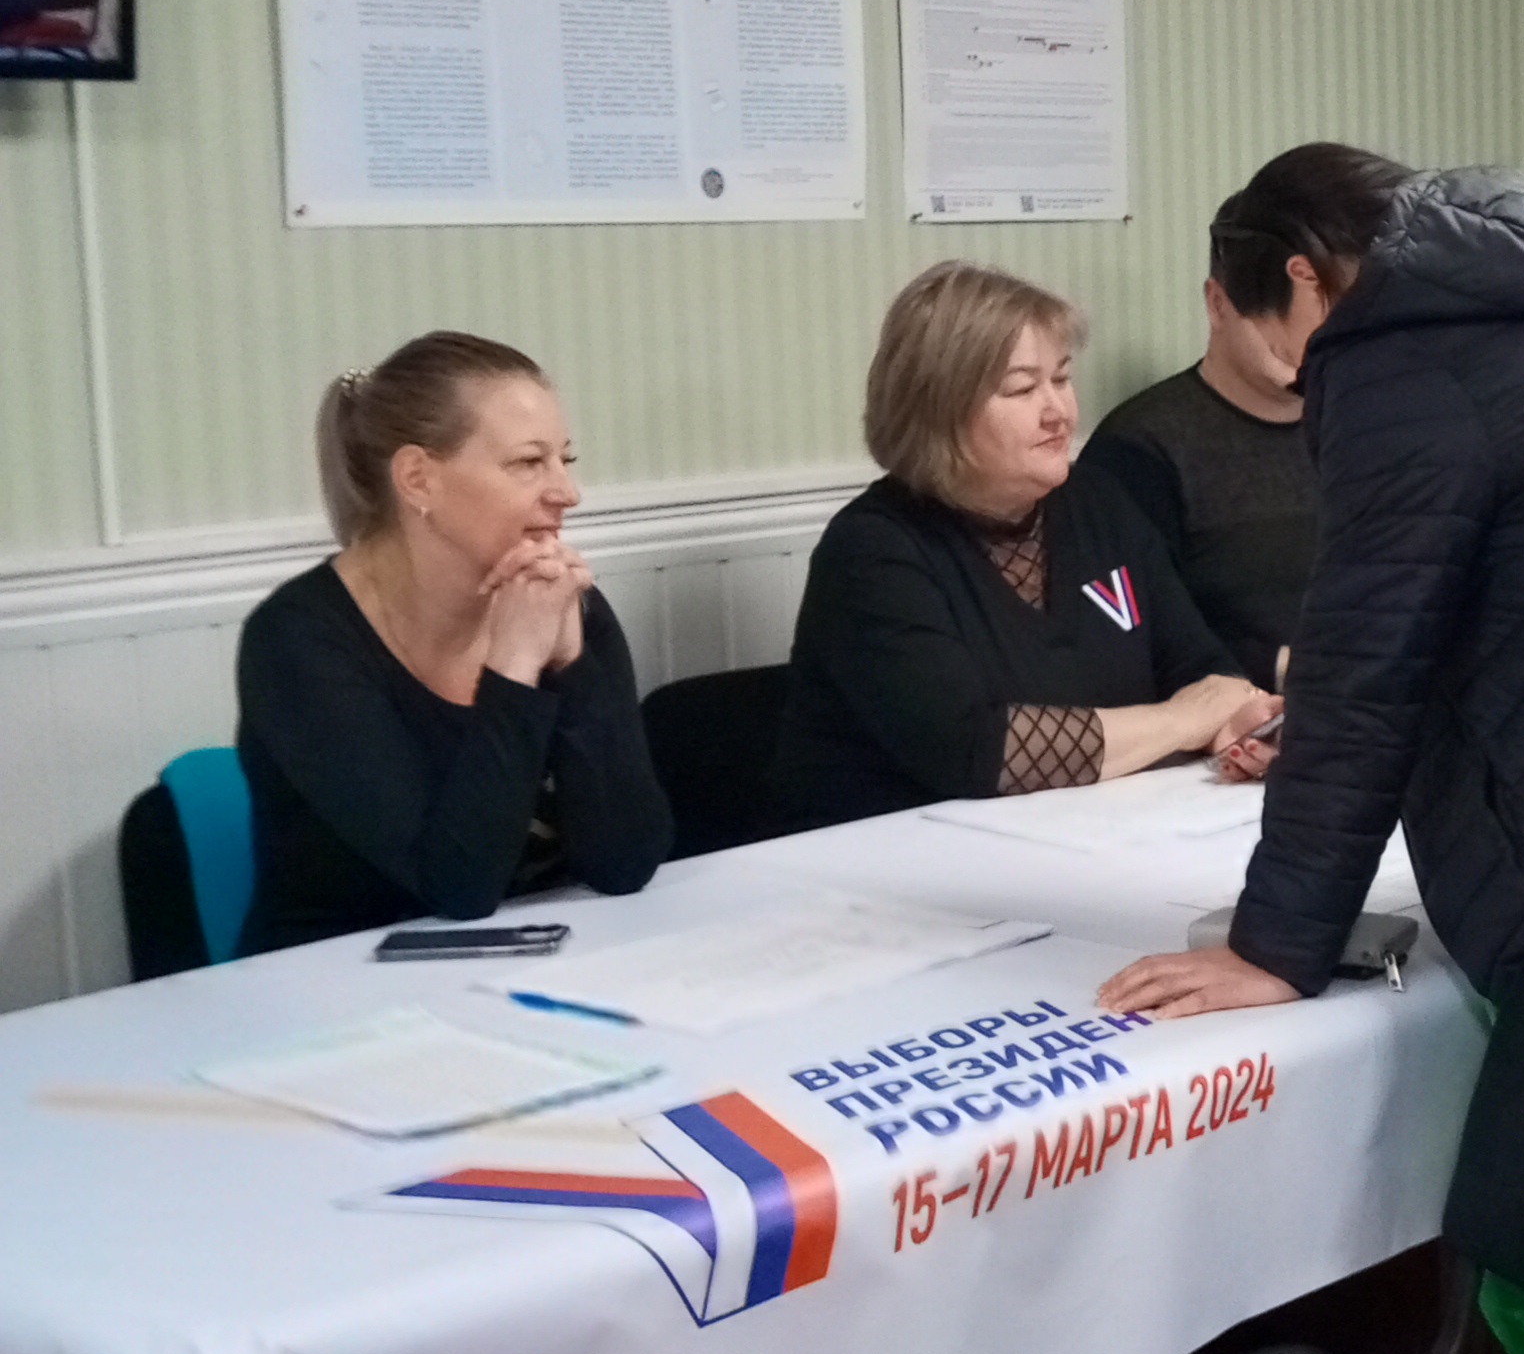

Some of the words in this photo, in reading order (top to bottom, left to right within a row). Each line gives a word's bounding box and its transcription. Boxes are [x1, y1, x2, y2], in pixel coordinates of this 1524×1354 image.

[789, 1000, 1070, 1093] ВЫБОРЫ
[825, 1010, 1154, 1119] ПРЕЗИДЕН
[865, 1052, 1131, 1157] РОССИИ
[1024, 1086, 1174, 1200] МАРТА
[1186, 1052, 1276, 1142] 2024
